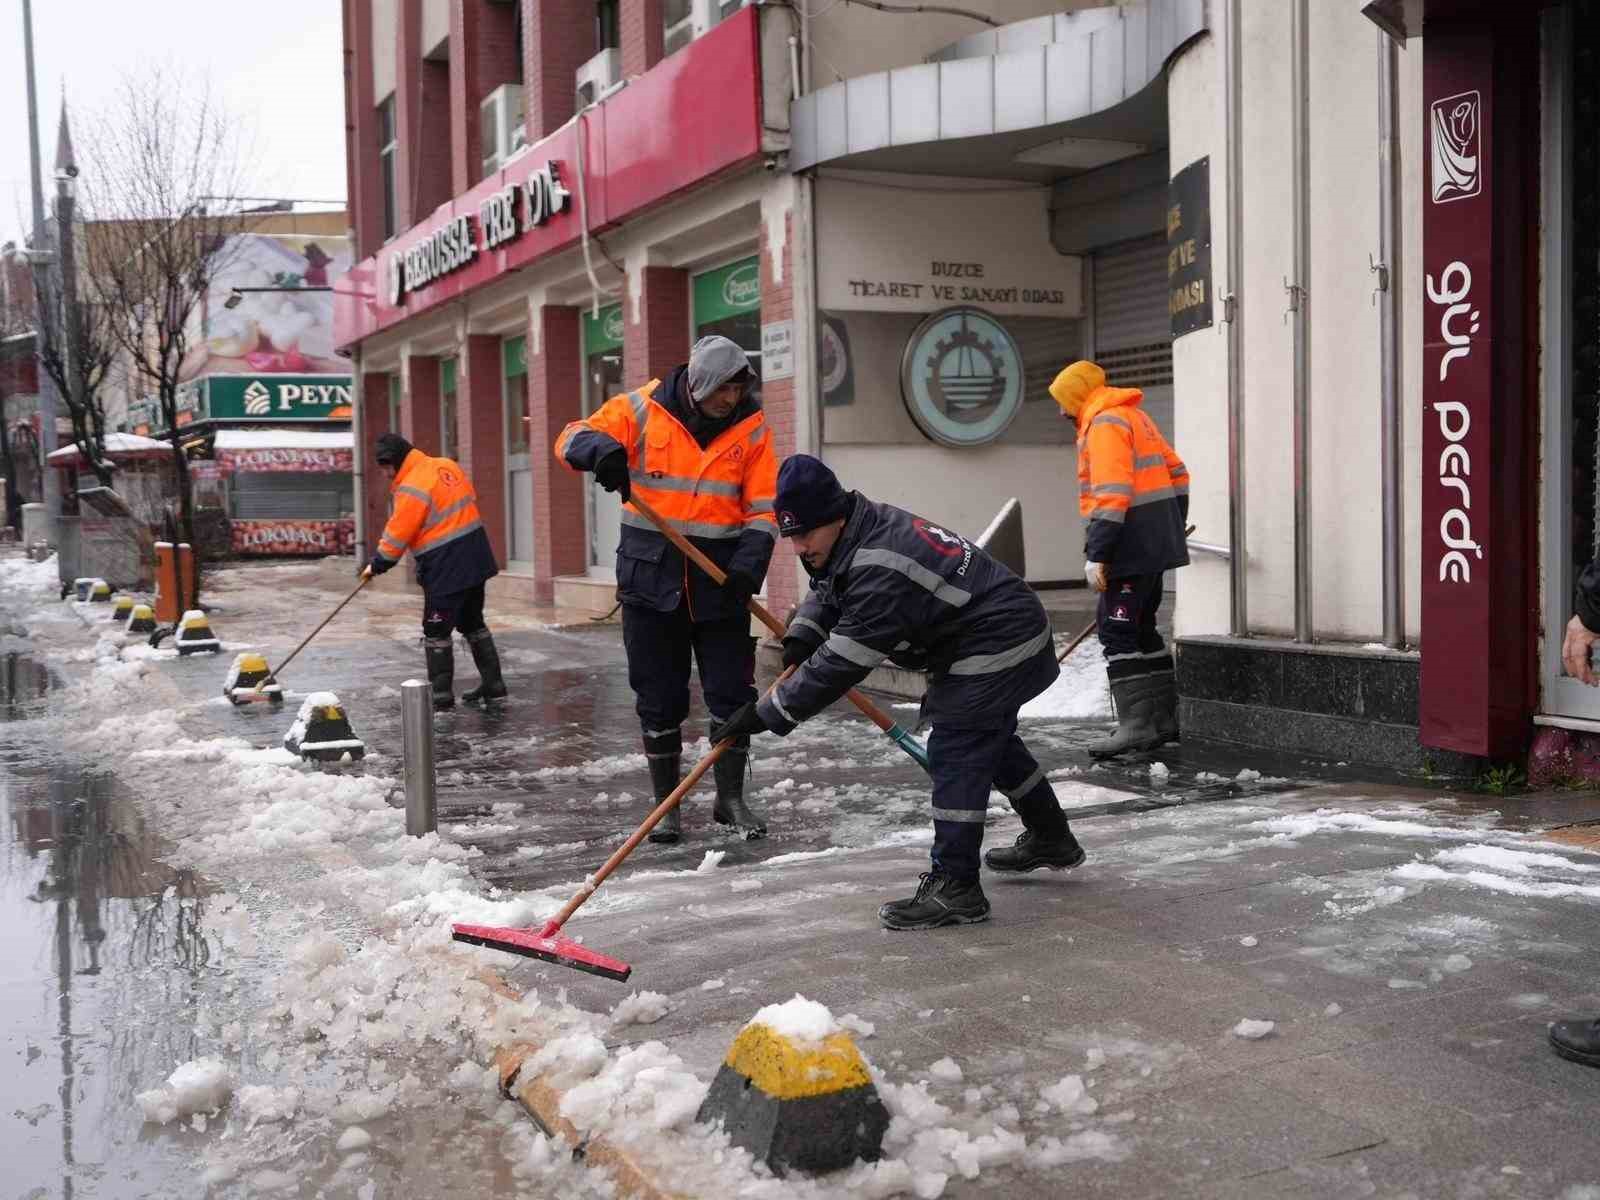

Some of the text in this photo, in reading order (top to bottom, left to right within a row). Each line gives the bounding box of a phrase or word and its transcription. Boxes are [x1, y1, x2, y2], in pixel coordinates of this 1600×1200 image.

[931, 285, 954, 300] VE
[1426, 261, 1482, 583] gül perde
